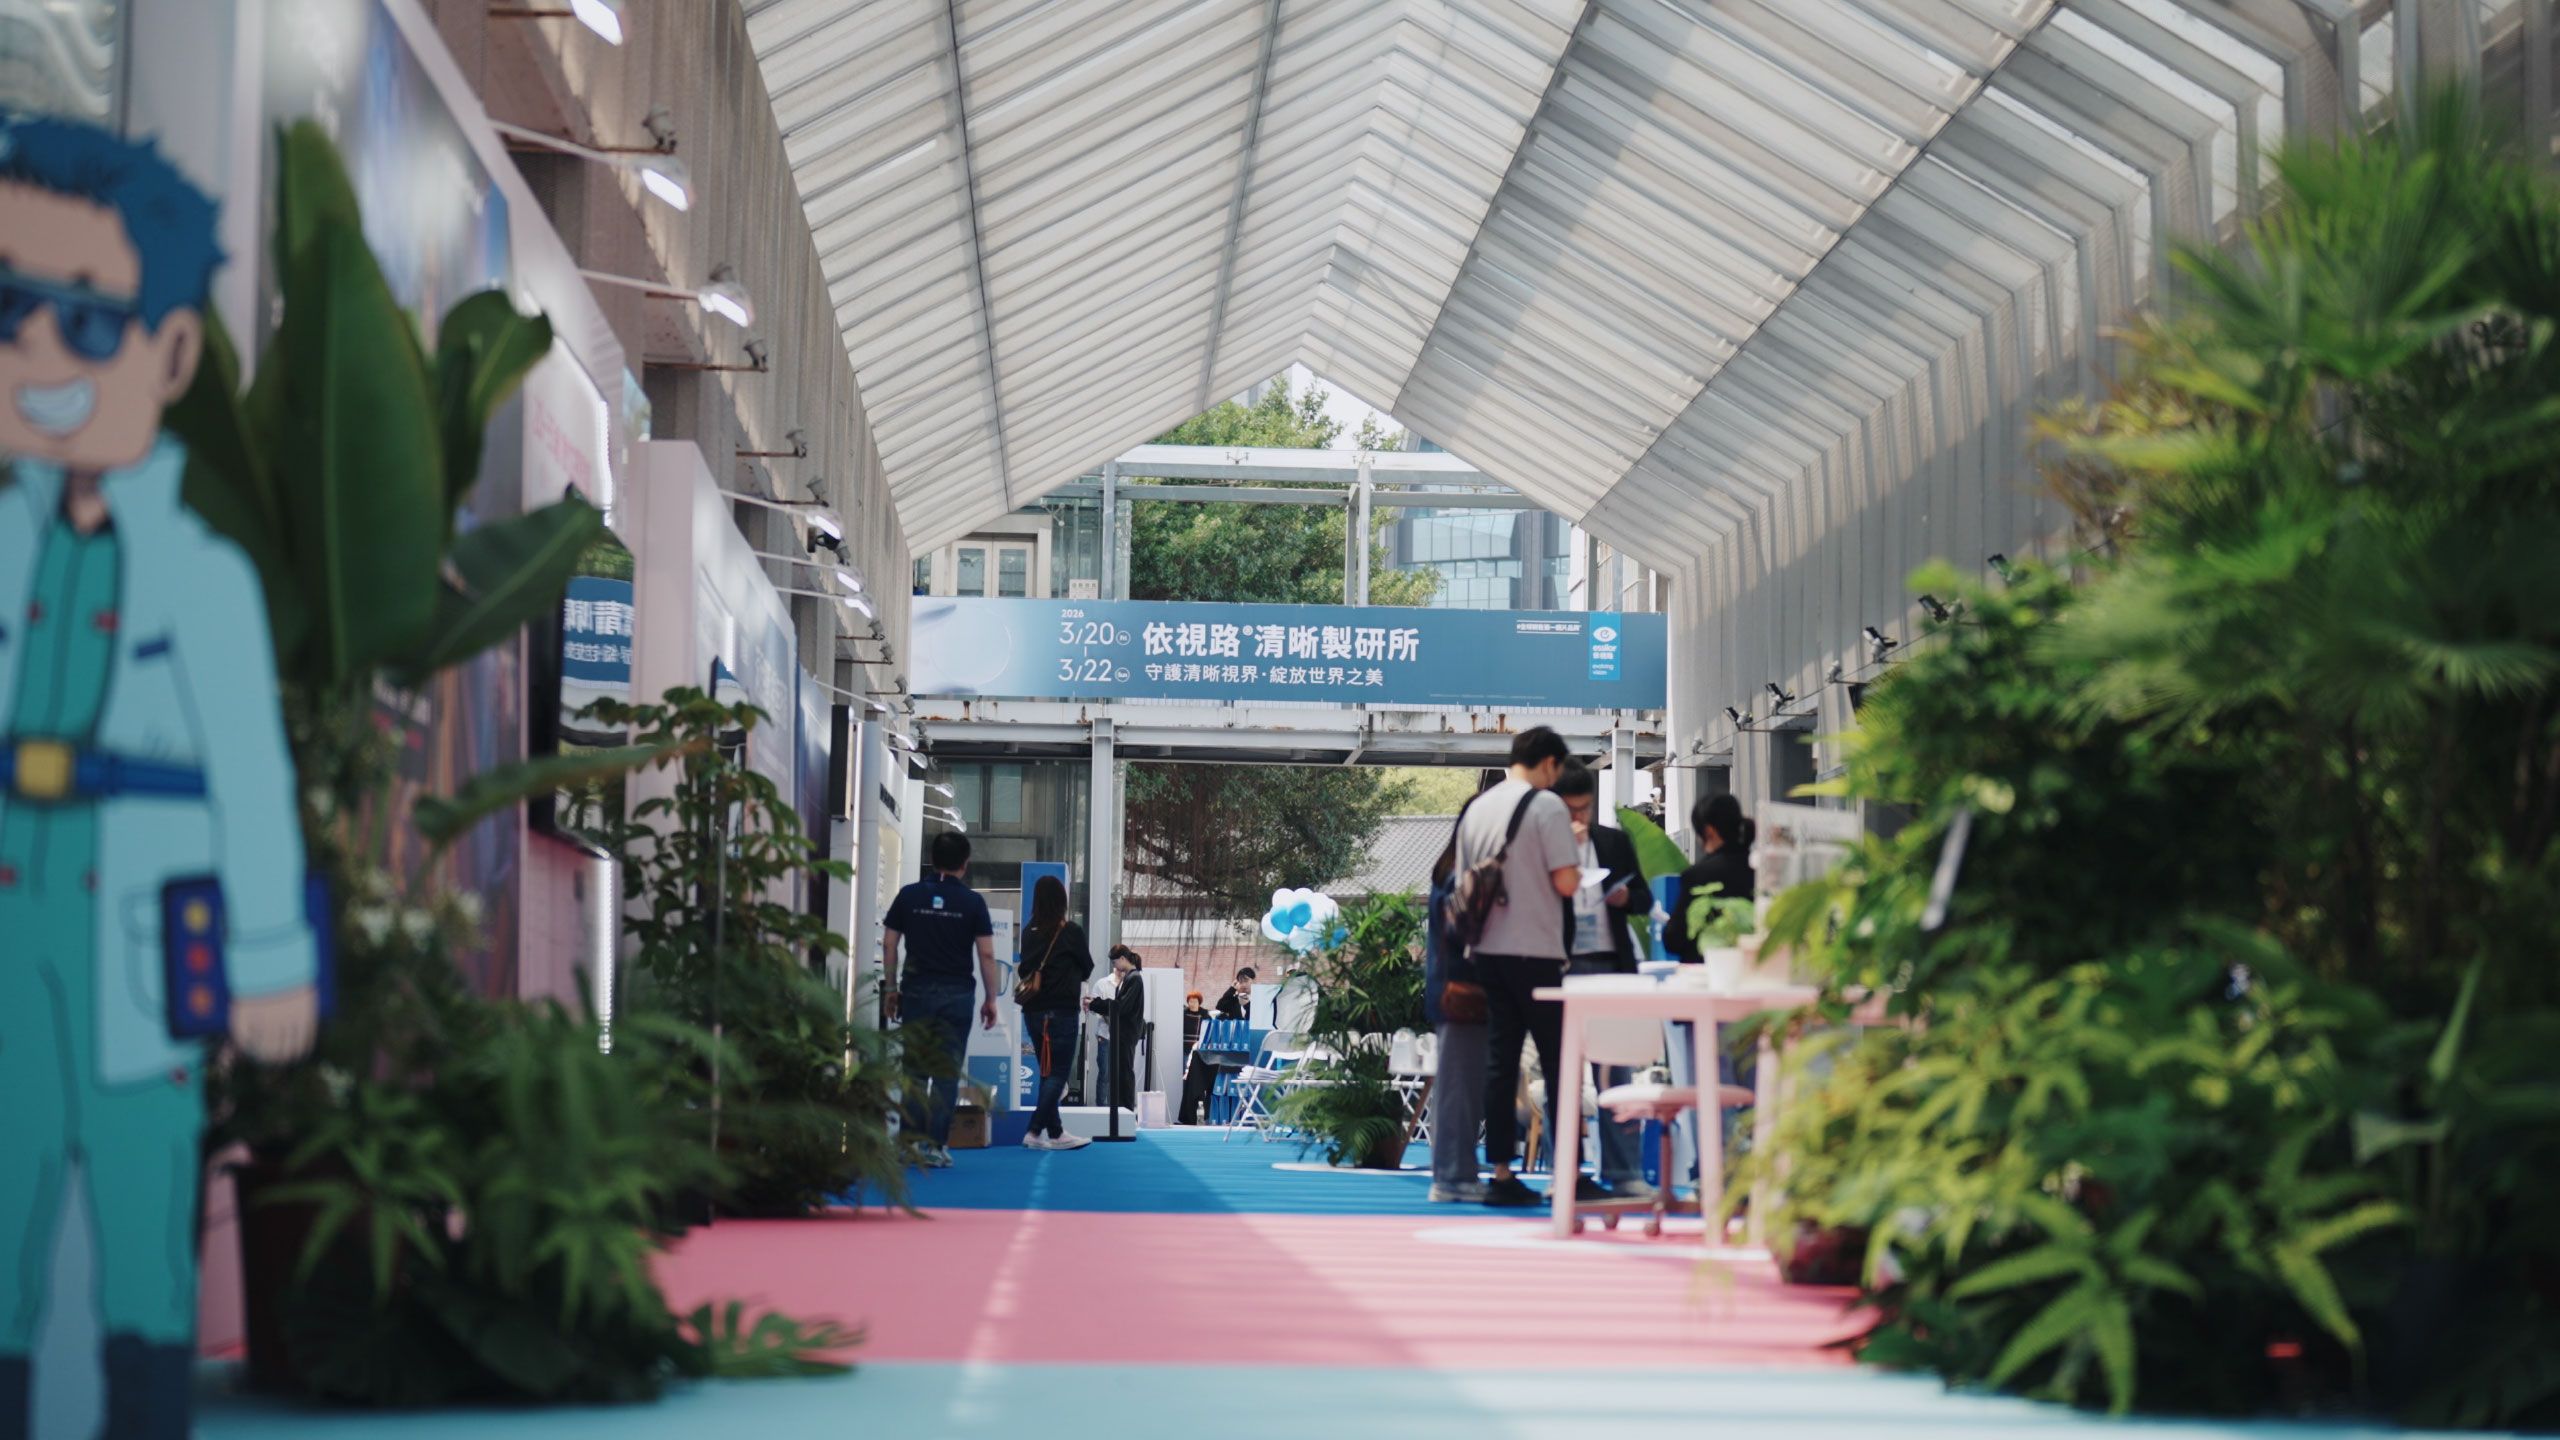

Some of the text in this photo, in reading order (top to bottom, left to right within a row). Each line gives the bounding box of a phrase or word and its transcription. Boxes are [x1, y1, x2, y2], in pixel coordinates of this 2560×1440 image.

[1061, 608, 1085, 618] 2026
[1058, 621, 1115, 645] 3/20
[1057, 658, 1112, 682] 3/22
